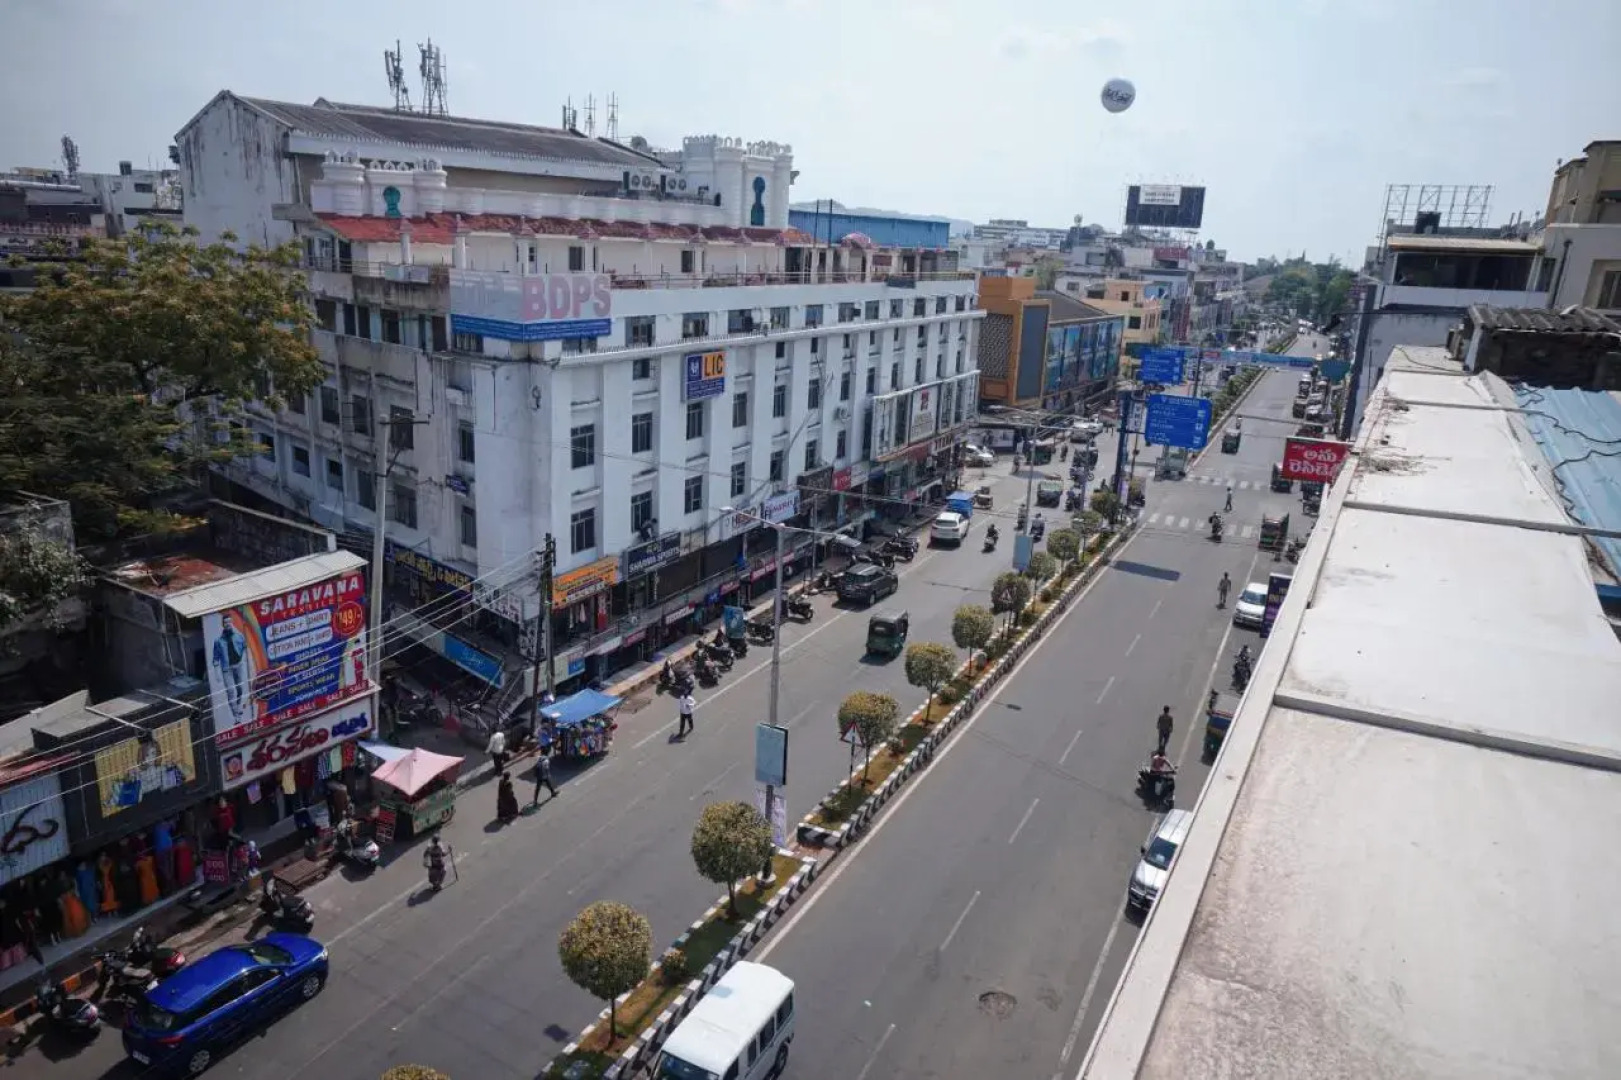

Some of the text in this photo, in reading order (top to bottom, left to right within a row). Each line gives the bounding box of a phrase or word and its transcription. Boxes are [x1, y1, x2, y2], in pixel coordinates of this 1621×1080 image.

[521, 274, 612, 320] BDPS
[704, 354, 724, 377] LIC
[260, 574, 360, 616] SARAVANA
[270, 622, 297, 637] JEANS
[215, 730, 239, 744] SALE
[243, 721, 265, 734] SALE
[272, 710, 294, 724] SALE
[297, 700, 317, 713] SALE
[326, 690, 344, 703] SALE
